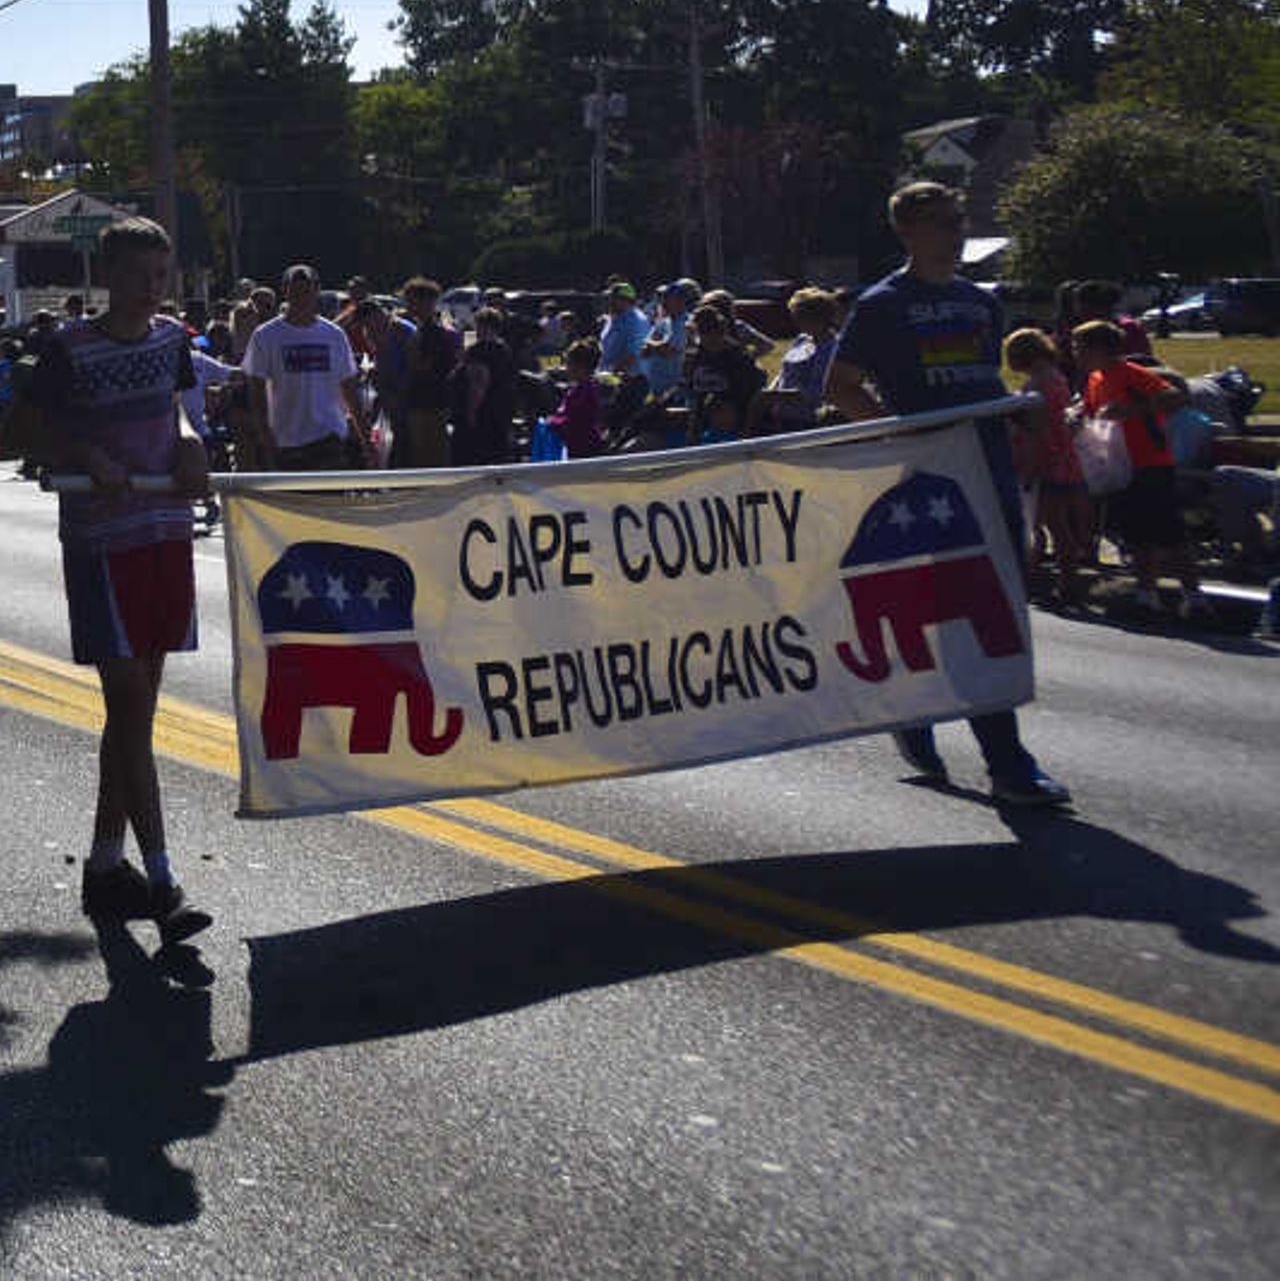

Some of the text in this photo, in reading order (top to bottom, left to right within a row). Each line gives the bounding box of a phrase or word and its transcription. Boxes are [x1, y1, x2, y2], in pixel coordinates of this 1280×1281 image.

[459, 489, 803, 601] CAPE COUNTY
[475, 615, 819, 742] REPUBLICANS
